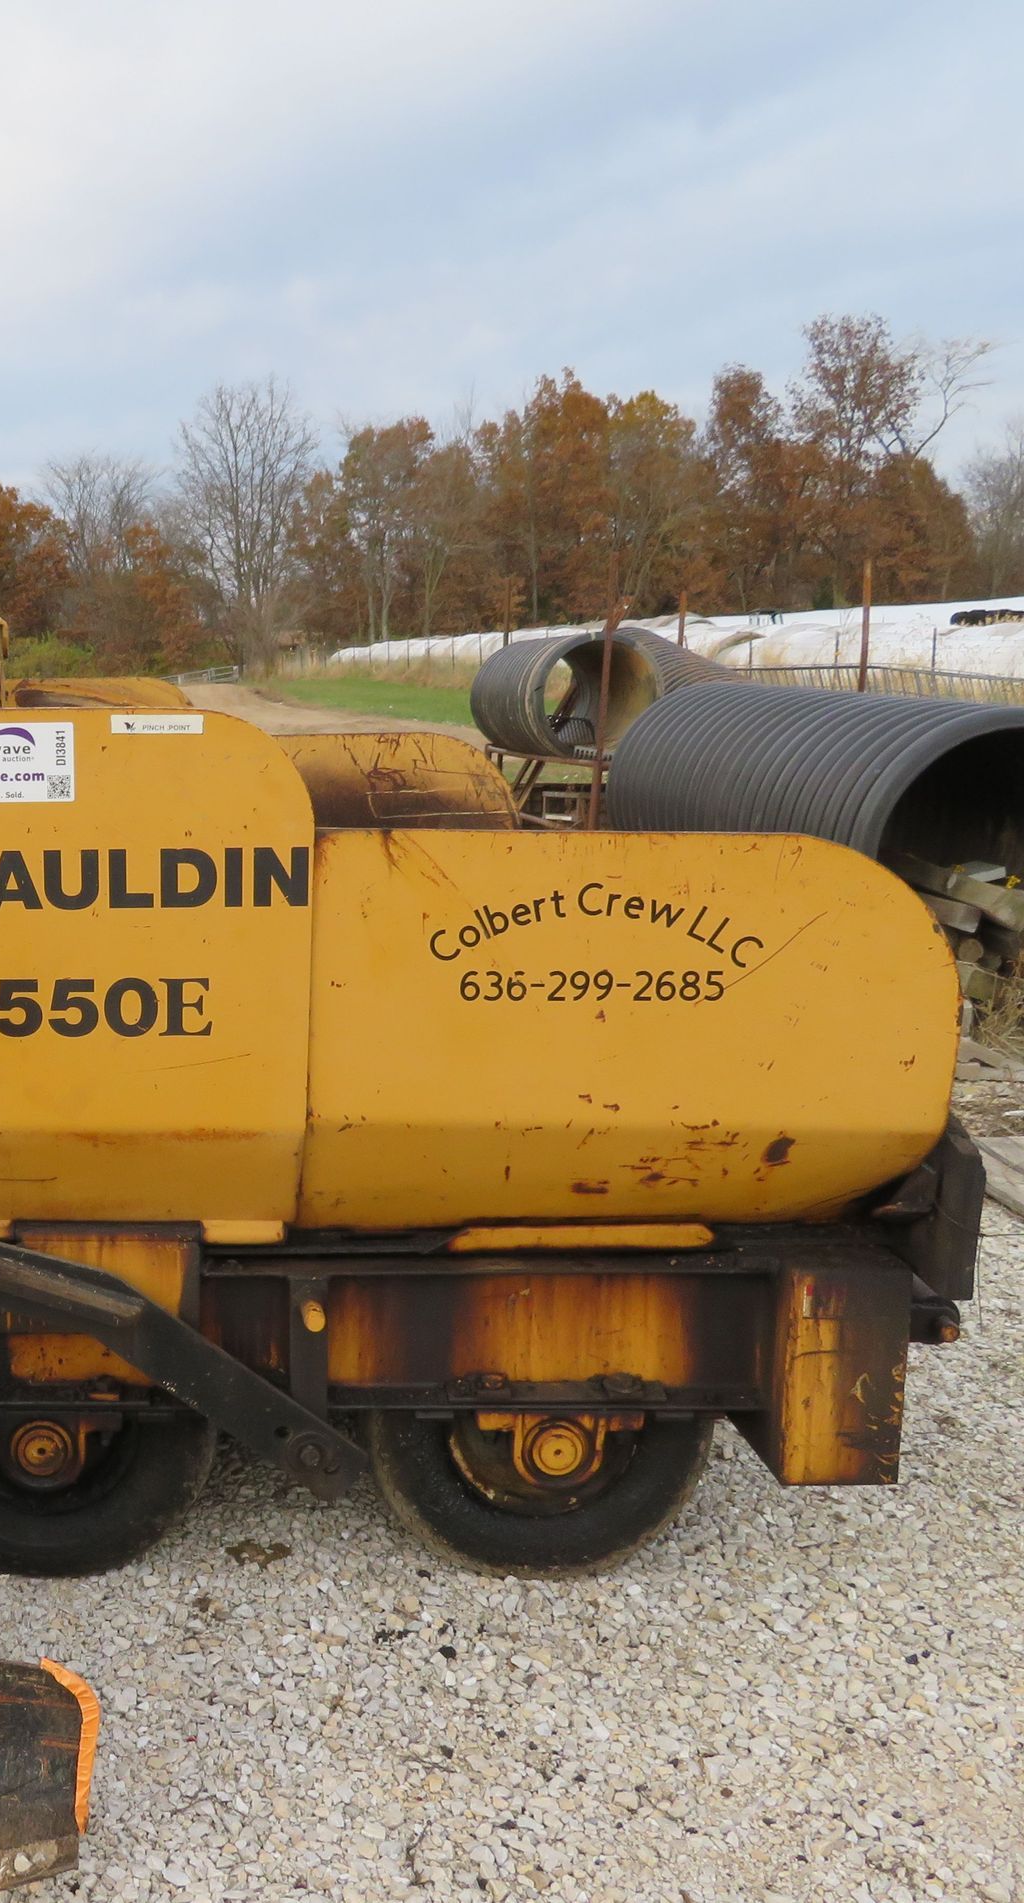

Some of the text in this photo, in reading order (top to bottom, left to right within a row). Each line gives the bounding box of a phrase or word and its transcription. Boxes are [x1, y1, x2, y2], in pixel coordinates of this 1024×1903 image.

[5, 791, 25, 799] Sold.
[429, 882, 765, 969] Colbert Crew LLC
[459, 970, 725, 1002] 636-299-2685
